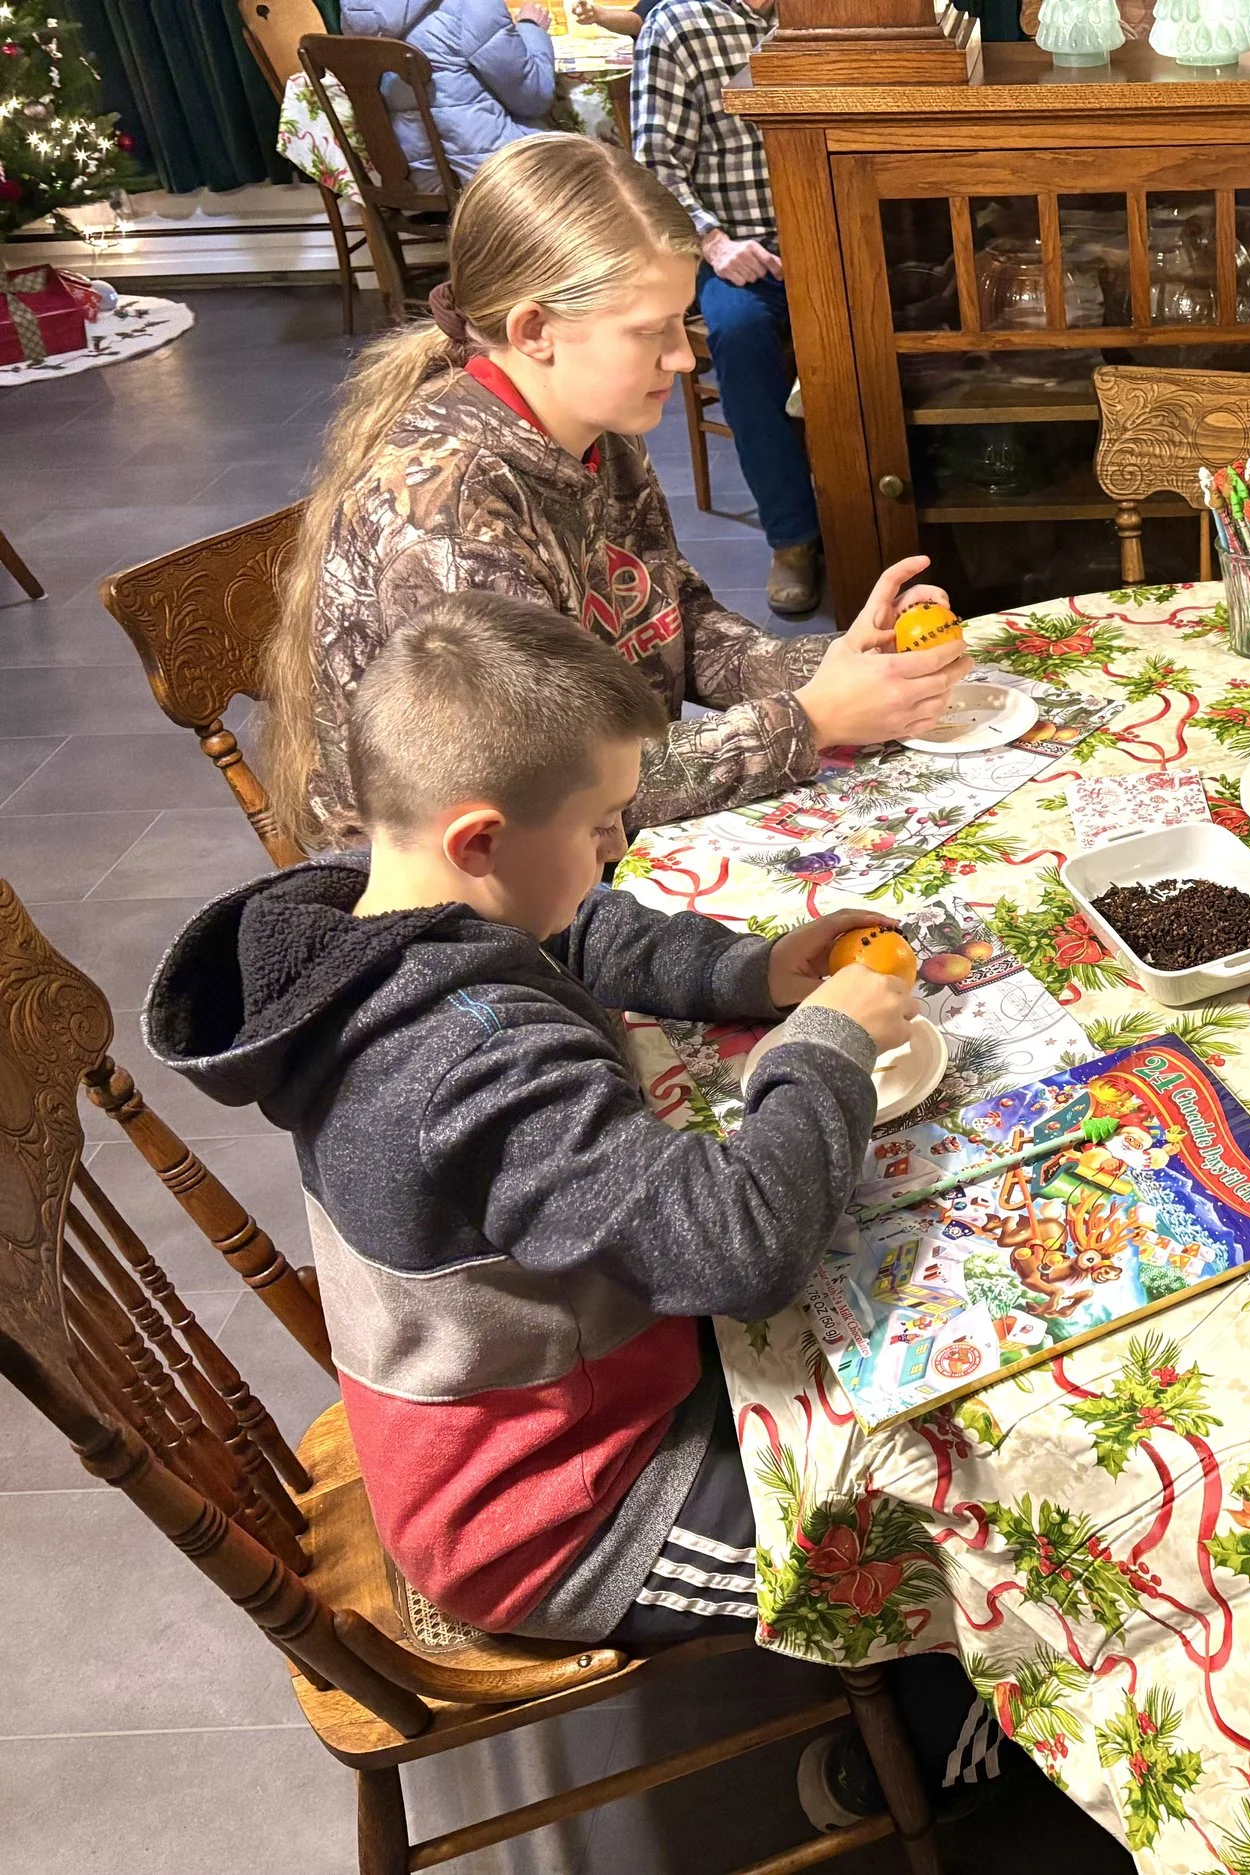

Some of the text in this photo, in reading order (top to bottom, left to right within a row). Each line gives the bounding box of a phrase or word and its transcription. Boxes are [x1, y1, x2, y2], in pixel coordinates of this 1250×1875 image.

[1133, 1057, 1187, 1094] 24
[1172, 1087, 1216, 1146] Chocolate
[1199, 1143, 1229, 1175] Days
[806, 1284, 840, 1340] 1.76 OZ (50 g)
[838, 1303, 854, 1322] Milk
[847, 1320, 870, 1356] Chocolates
